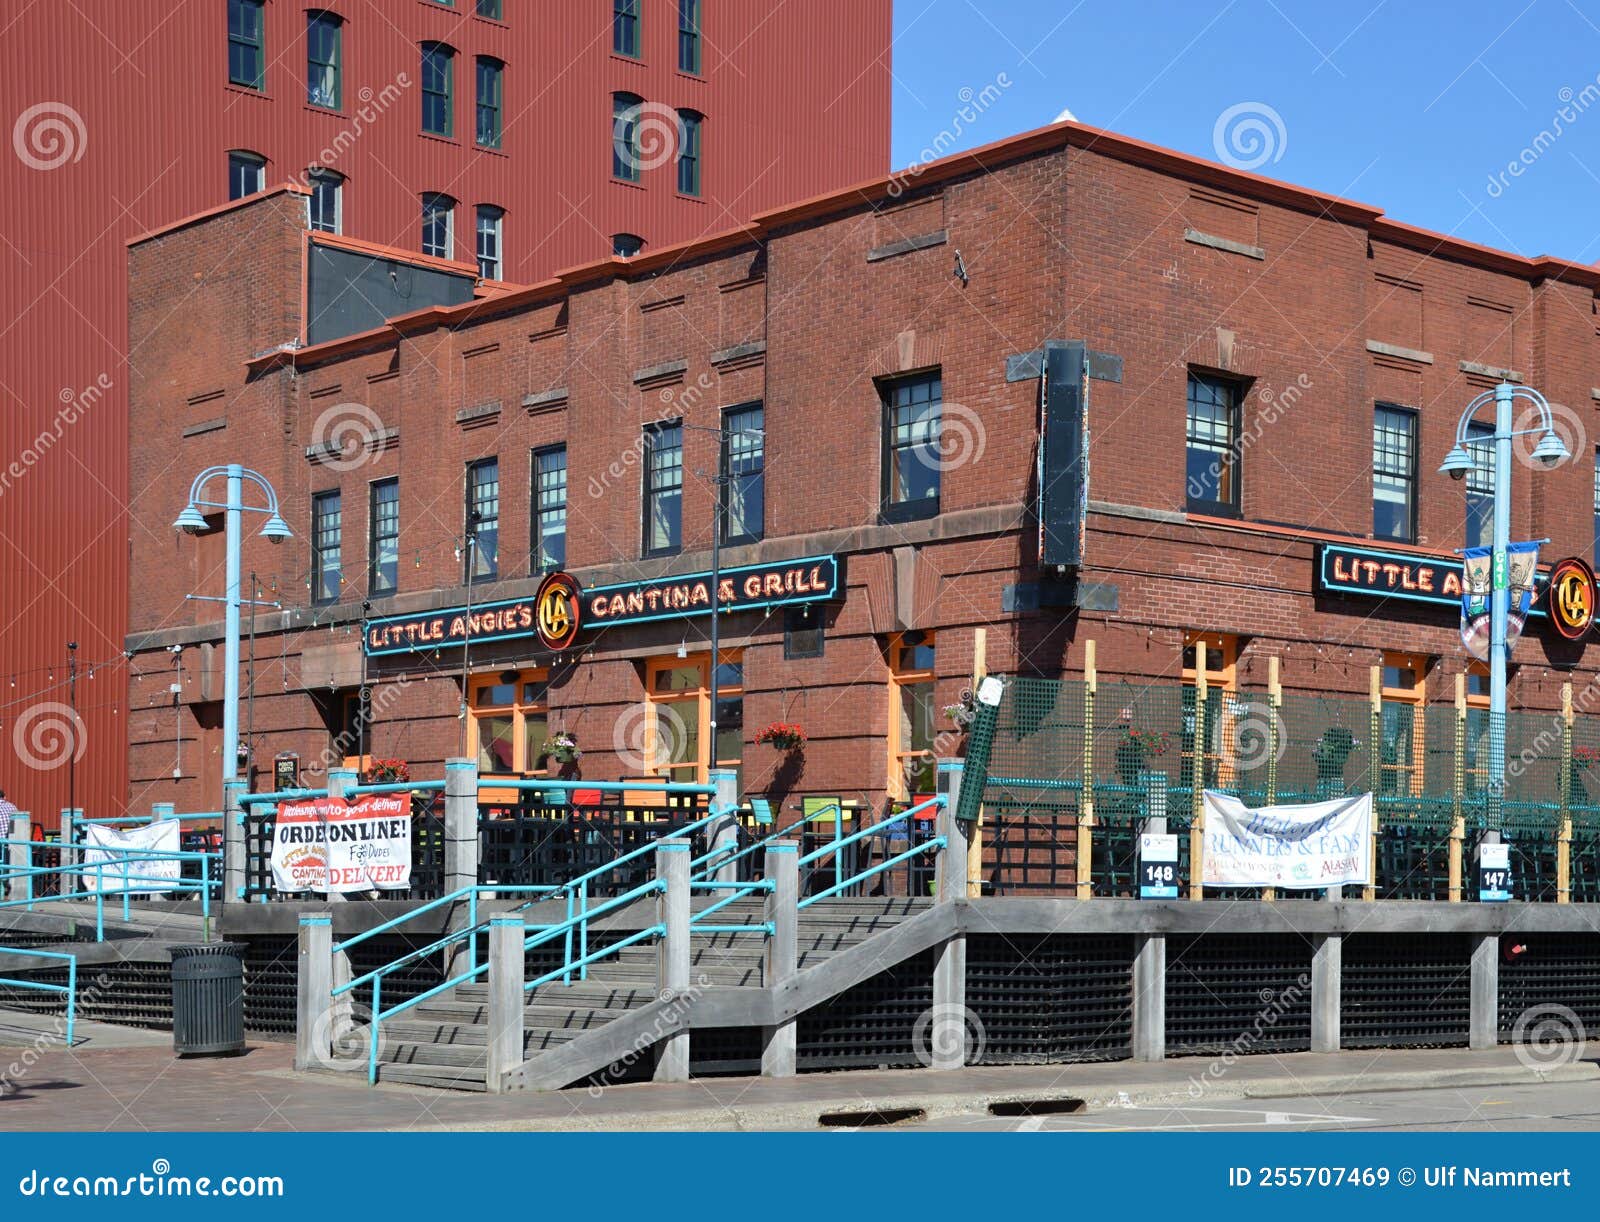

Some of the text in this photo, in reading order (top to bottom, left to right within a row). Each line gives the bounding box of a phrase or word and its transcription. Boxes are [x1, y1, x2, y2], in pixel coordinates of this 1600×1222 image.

[1333, 555, 1435, 592] LITTLE
[590, 566, 827, 617] CANTINA & GRILL
[370, 604, 532, 647] LITTLE ANGIE'S
[280, 819, 407, 844] ORDE ONLINE!
[1320, 832, 1361, 855] FANS
[292, 868, 326, 880] CANTINA
[329, 865, 406, 885] DELIVERY
[1146, 865, 1174, 881] 148
[1484, 871, 1505, 886] 147
